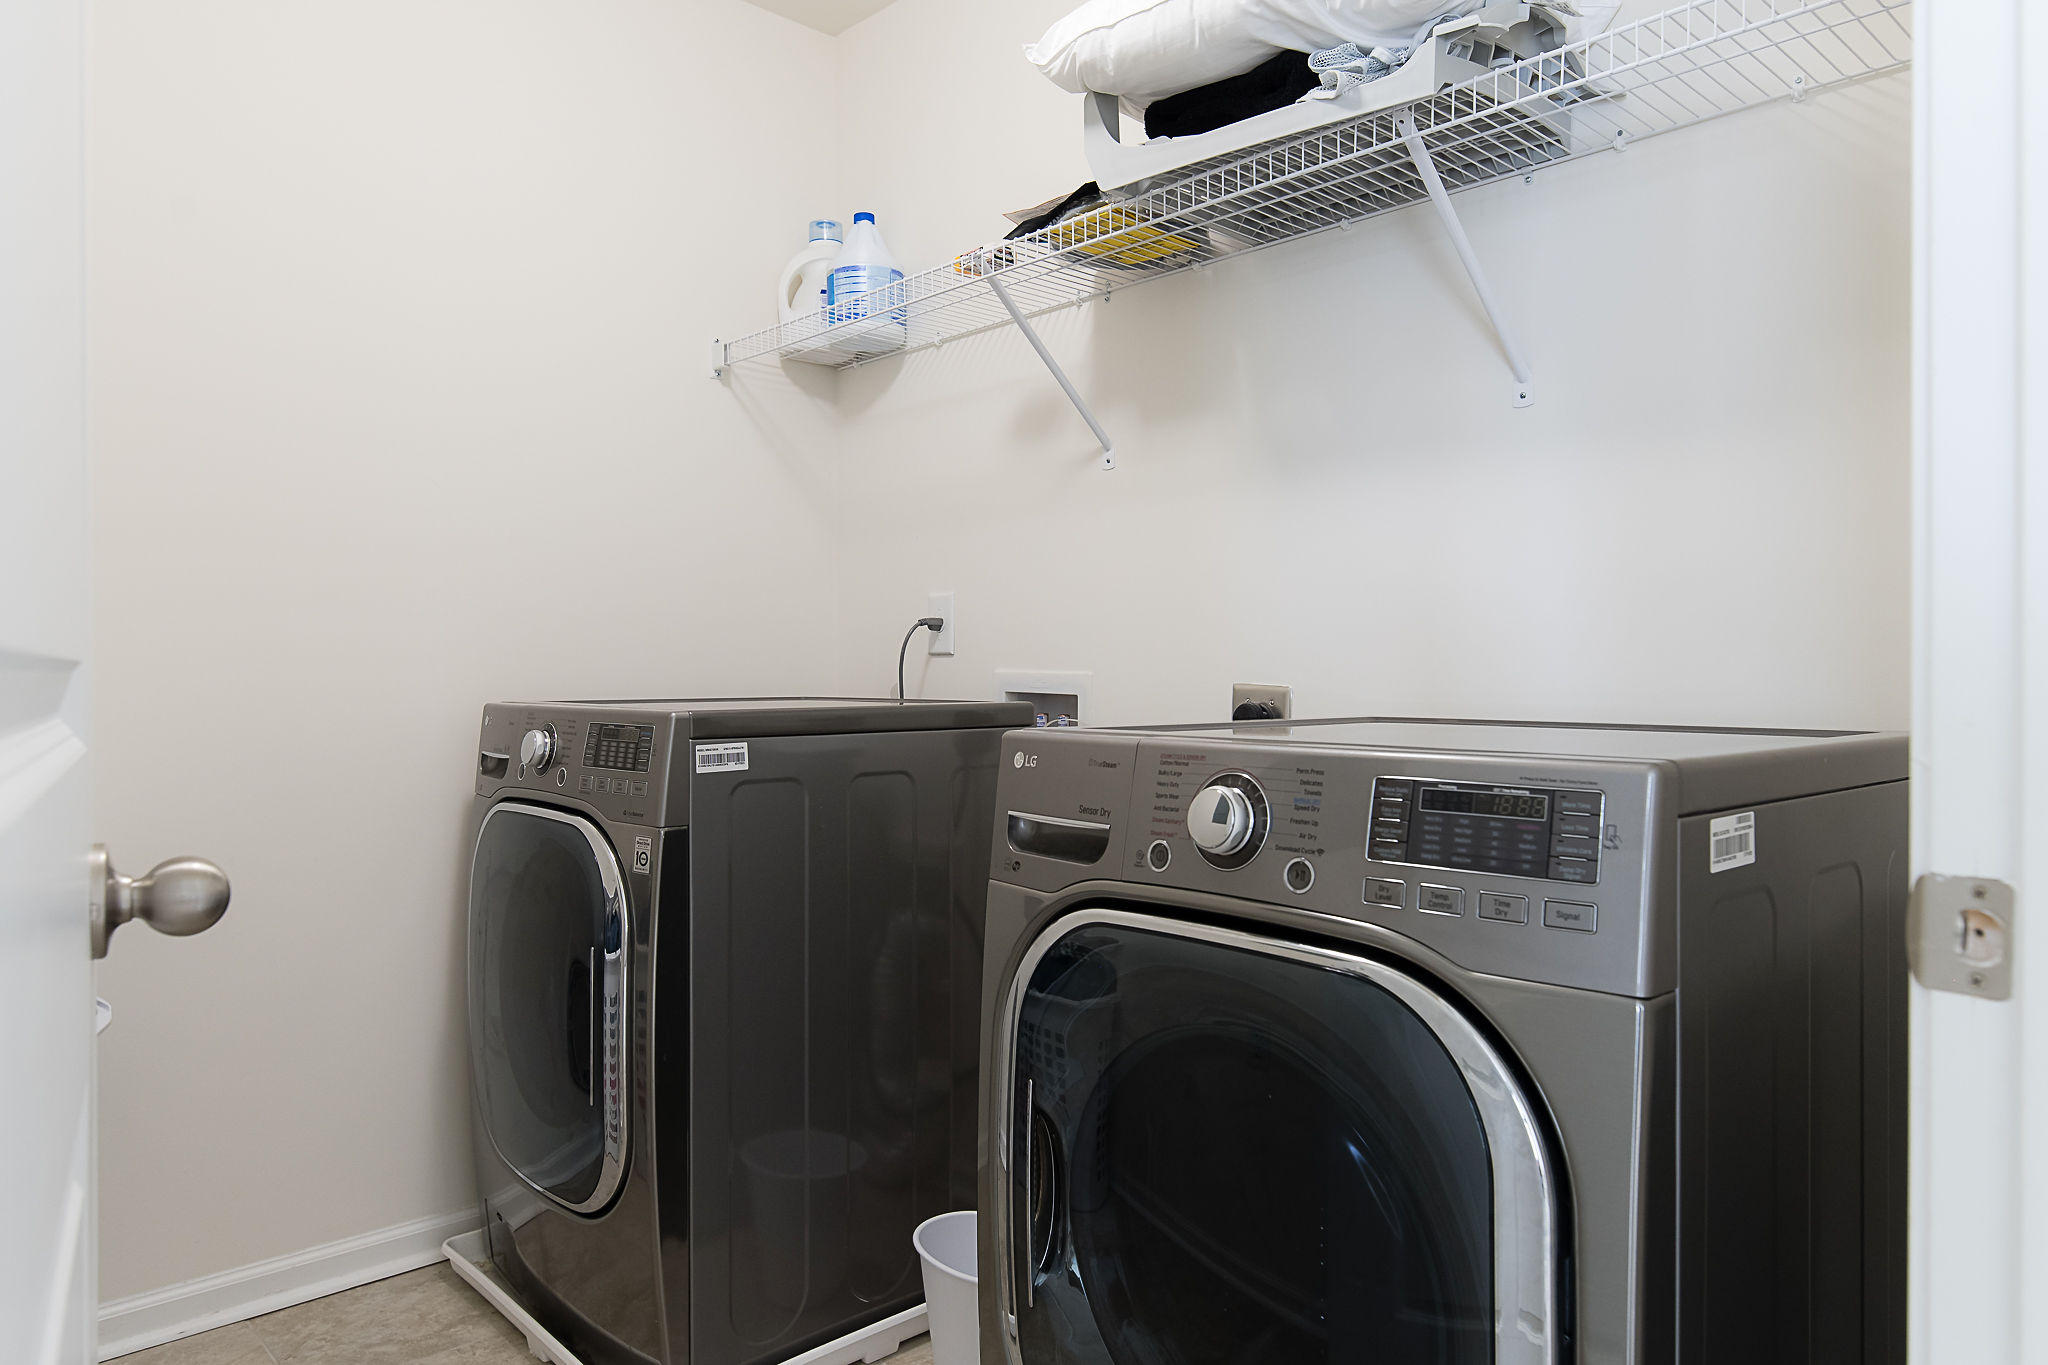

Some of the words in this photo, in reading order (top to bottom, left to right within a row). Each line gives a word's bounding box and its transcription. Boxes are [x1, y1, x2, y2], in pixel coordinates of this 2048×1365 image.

[1025, 755, 1038, 768] LG
[1079, 804, 1099, 816] Sensor
[1100, 808, 1112, 818] Dry
[635, 851, 649, 867] 10
[1378, 884, 1390, 894] Dry
[1375, 893, 1392, 902] Level
[1427, 900, 1454, 911] Control
[1493, 899, 1511, 909] Time
[1494, 907, 1508, 918] Dry
[1556, 910, 1581, 923] Signal
